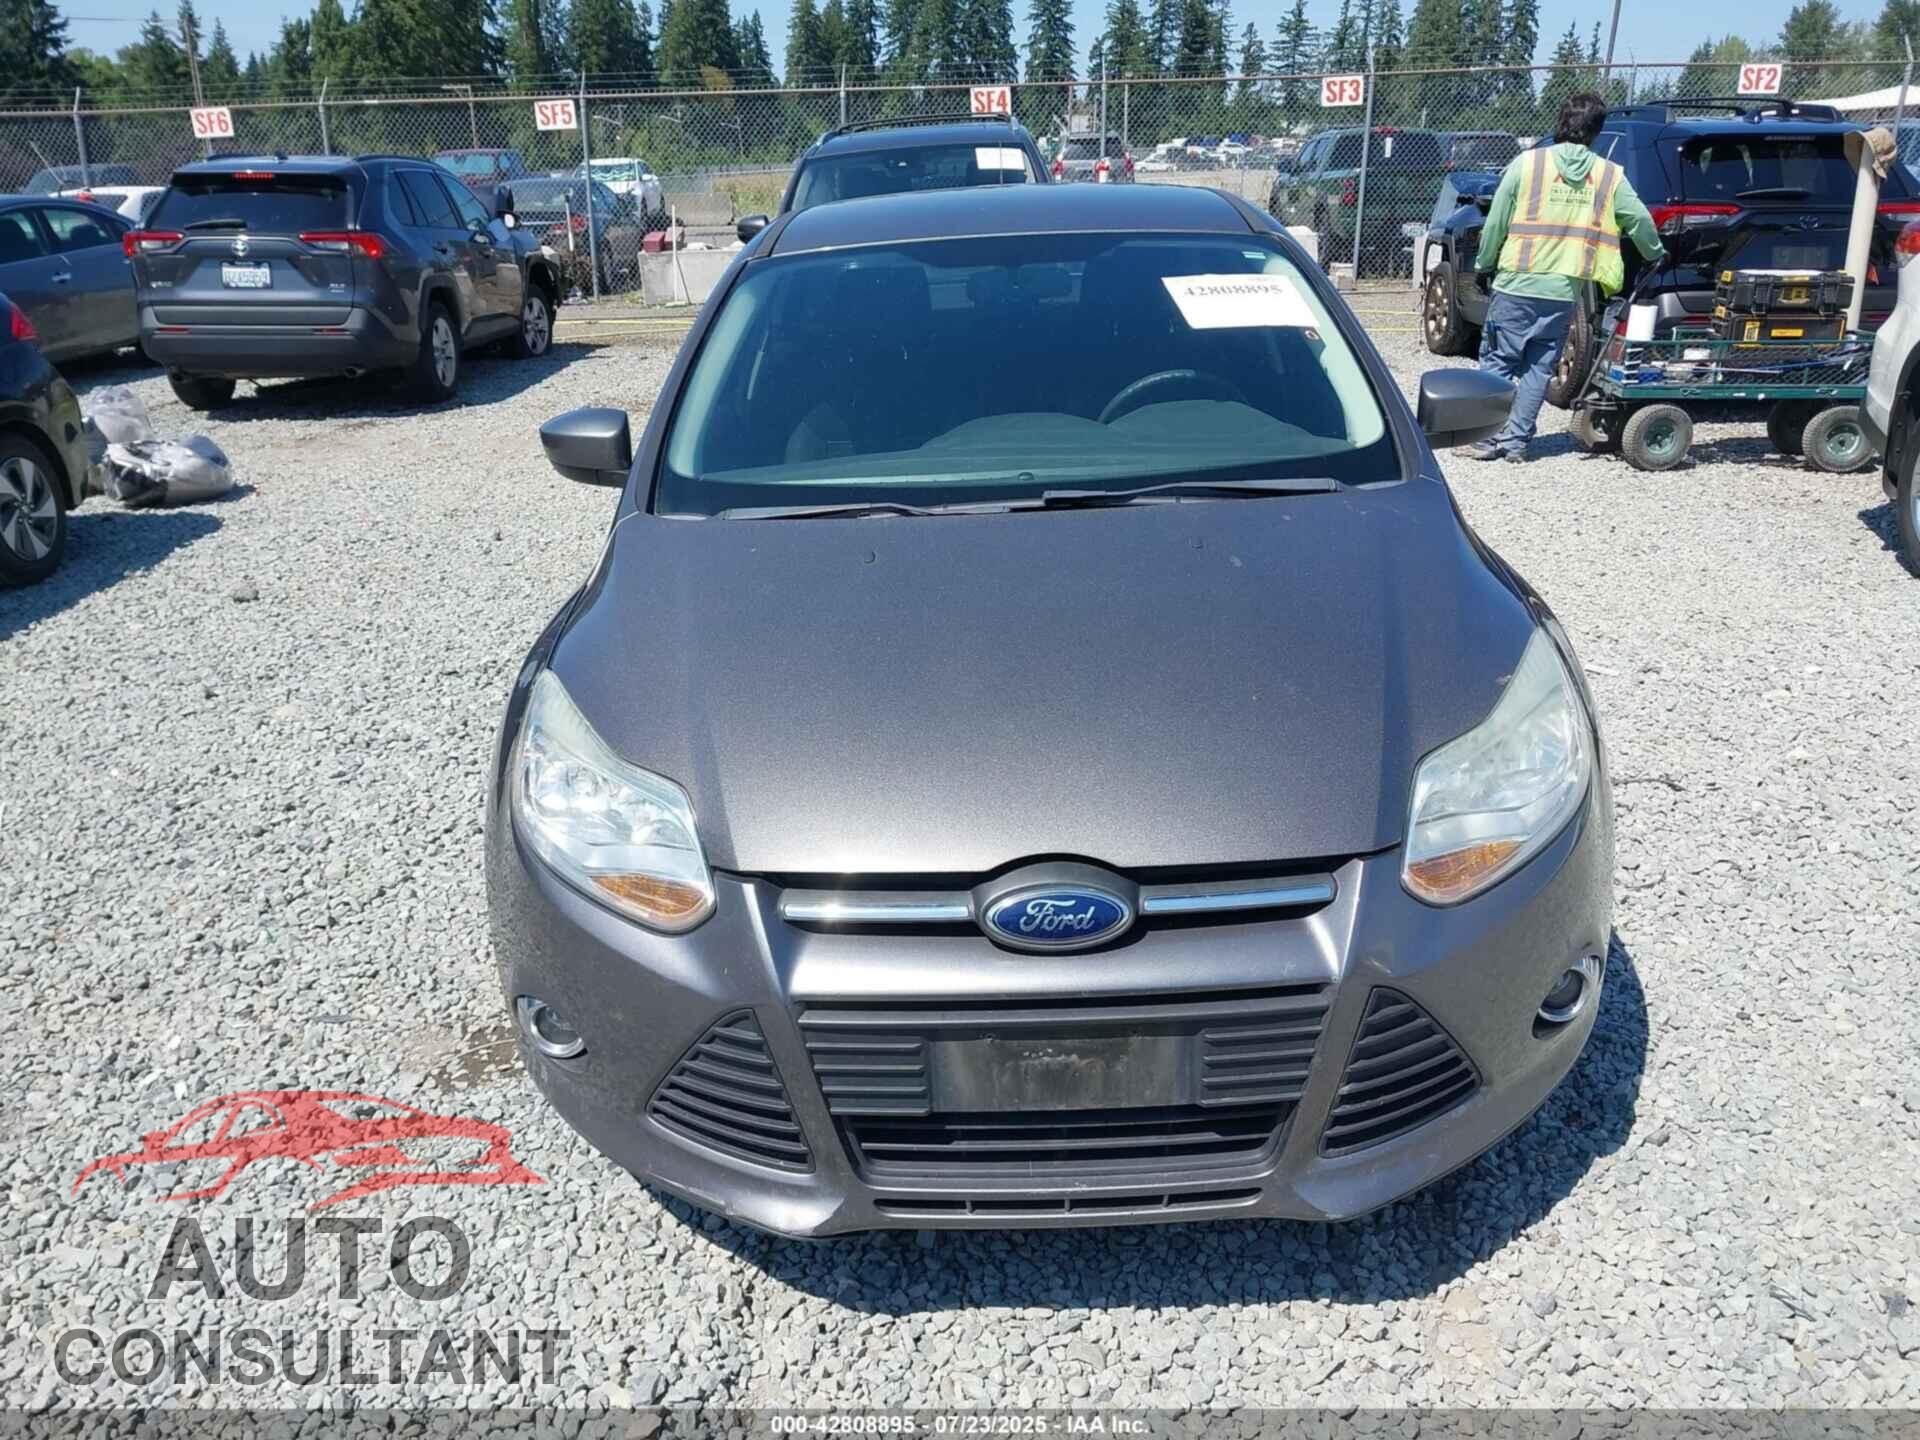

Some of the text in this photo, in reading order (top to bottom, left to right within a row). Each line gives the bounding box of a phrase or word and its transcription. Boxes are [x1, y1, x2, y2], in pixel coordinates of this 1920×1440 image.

[1742, 67, 1778, 91] SF2
[975, 90, 1008, 112] SF4
[1326, 79, 1361, 103] SF3
[194, 111, 229, 134] SF6
[538, 103, 572, 126] SF5
[1183, 284, 1283, 297] 42808895
[1019, 899, 1096, 932] Ford
